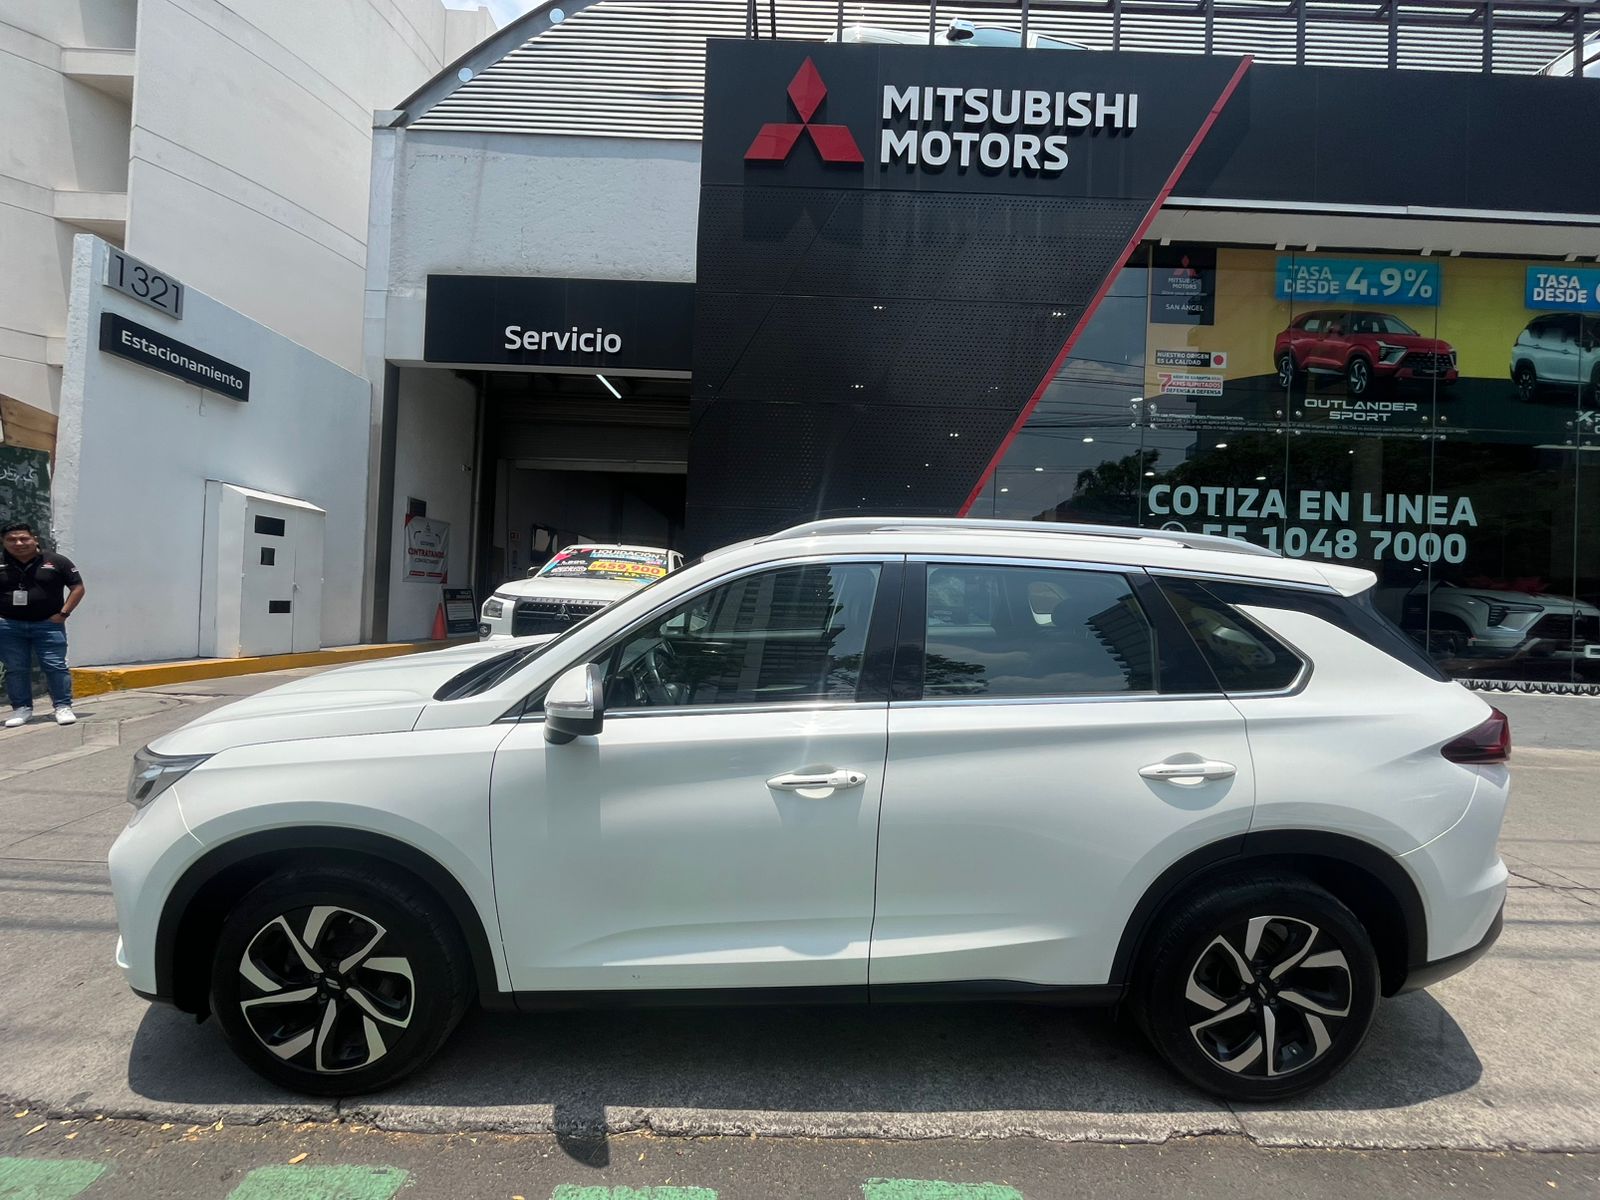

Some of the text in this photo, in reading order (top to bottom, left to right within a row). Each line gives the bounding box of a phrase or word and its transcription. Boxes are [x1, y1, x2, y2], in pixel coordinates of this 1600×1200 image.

[882, 85, 1138, 129] MITSUBISHI
[880, 129, 1070, 171] MOTORS
[1288, 265, 1333, 280] TASA
[1345, 266, 1433, 298] 4.9%
[1536, 274, 1581, 290] TASA
[115, 254, 181, 314] 1321
[1283, 279, 1340, 295] DESDE
[1533, 288, 1588, 304] DESDE
[1165, 303, 1180, 311] SAN
[504, 325, 622, 353] Servicio
[121, 329, 243, 390] Estacionamiento
[1158, 373, 1173, 393] 7
[1304, 398, 1418, 412] OUTLANDER
[1328, 411, 1392, 422] SPORT
[1148, 483, 1478, 527] COTIZA EN LINEA
[591, 549, 660, 560] LIQUIDACIÓN
[1262, 526, 1358, 560] 1048
[1370, 530, 1467, 564] 7000
